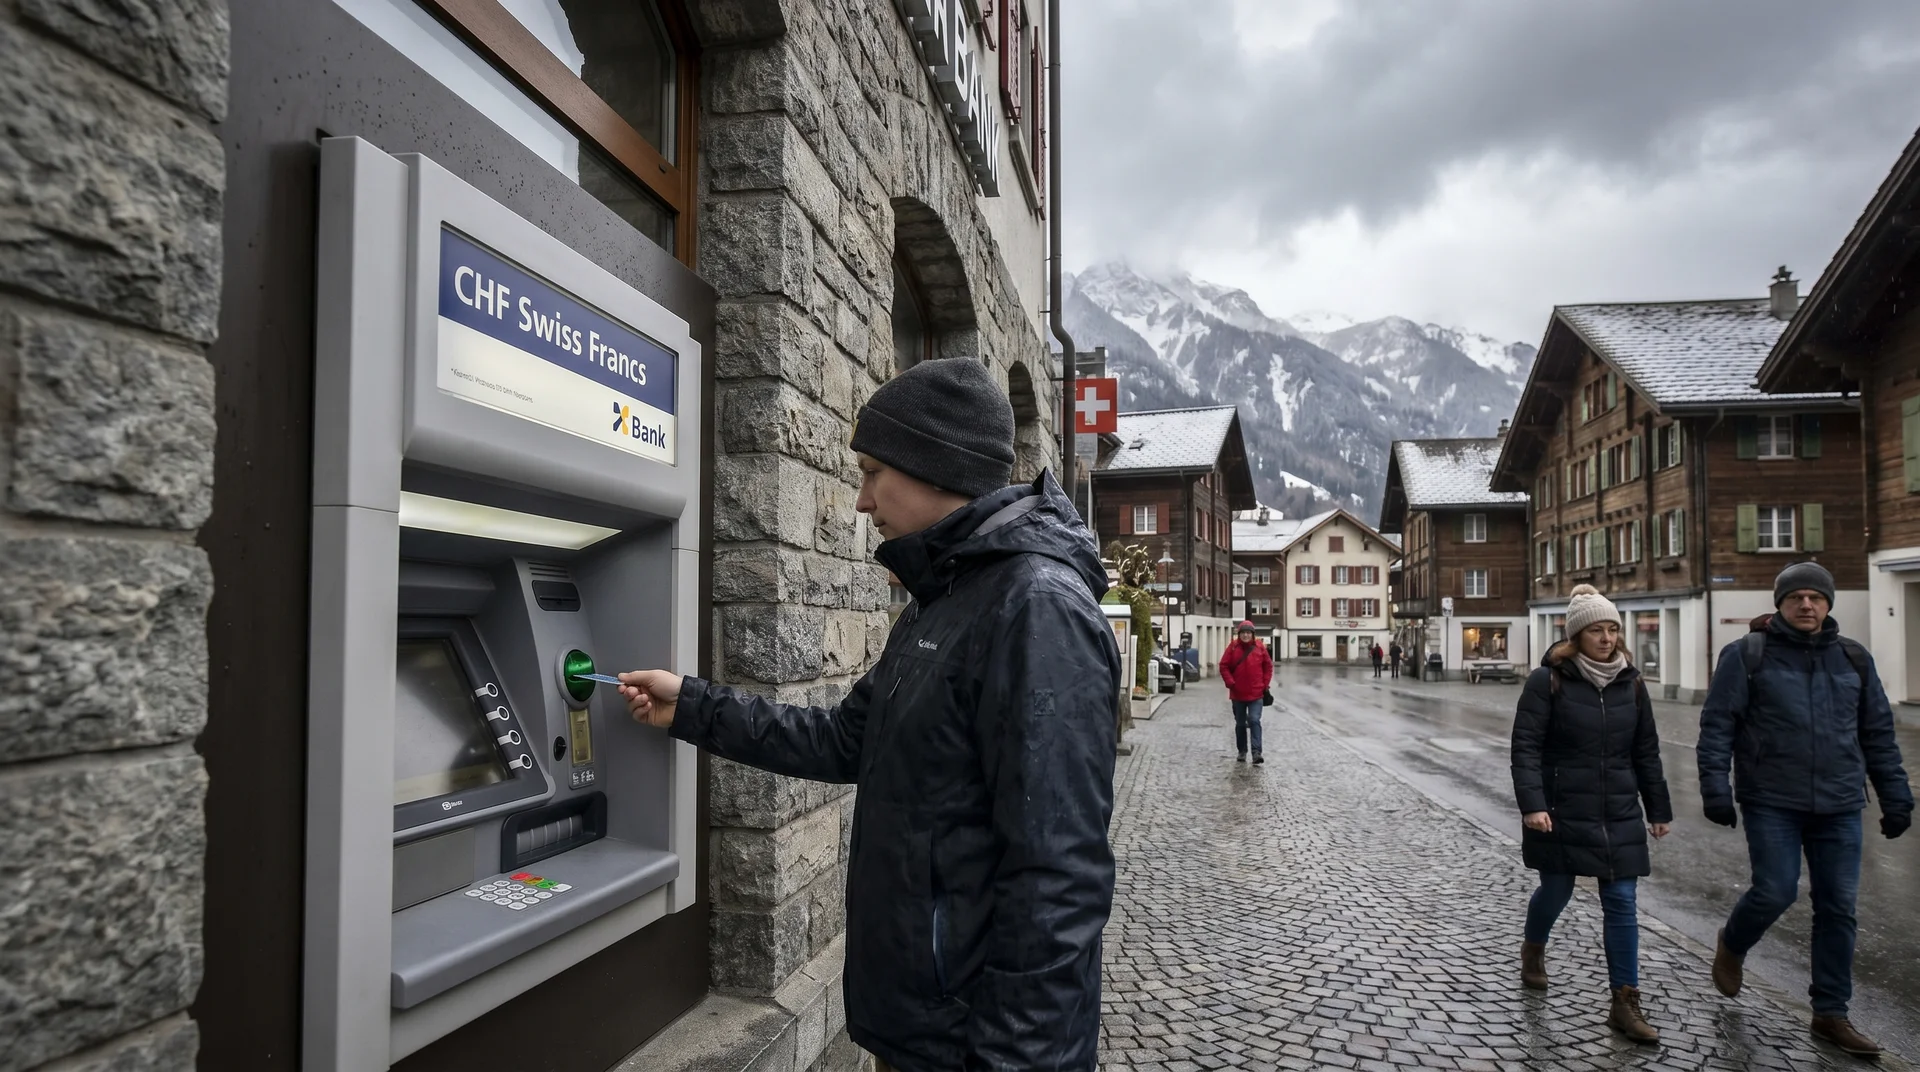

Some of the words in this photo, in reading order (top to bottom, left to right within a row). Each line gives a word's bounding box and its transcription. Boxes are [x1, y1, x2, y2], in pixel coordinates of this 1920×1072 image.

[954, 0, 1001, 197] BANK
[454, 265, 510, 320] CHF
[518, 295, 582, 356] Swiss
[589, 330, 647, 386] Francs
[632, 415, 666, 449] Bank
